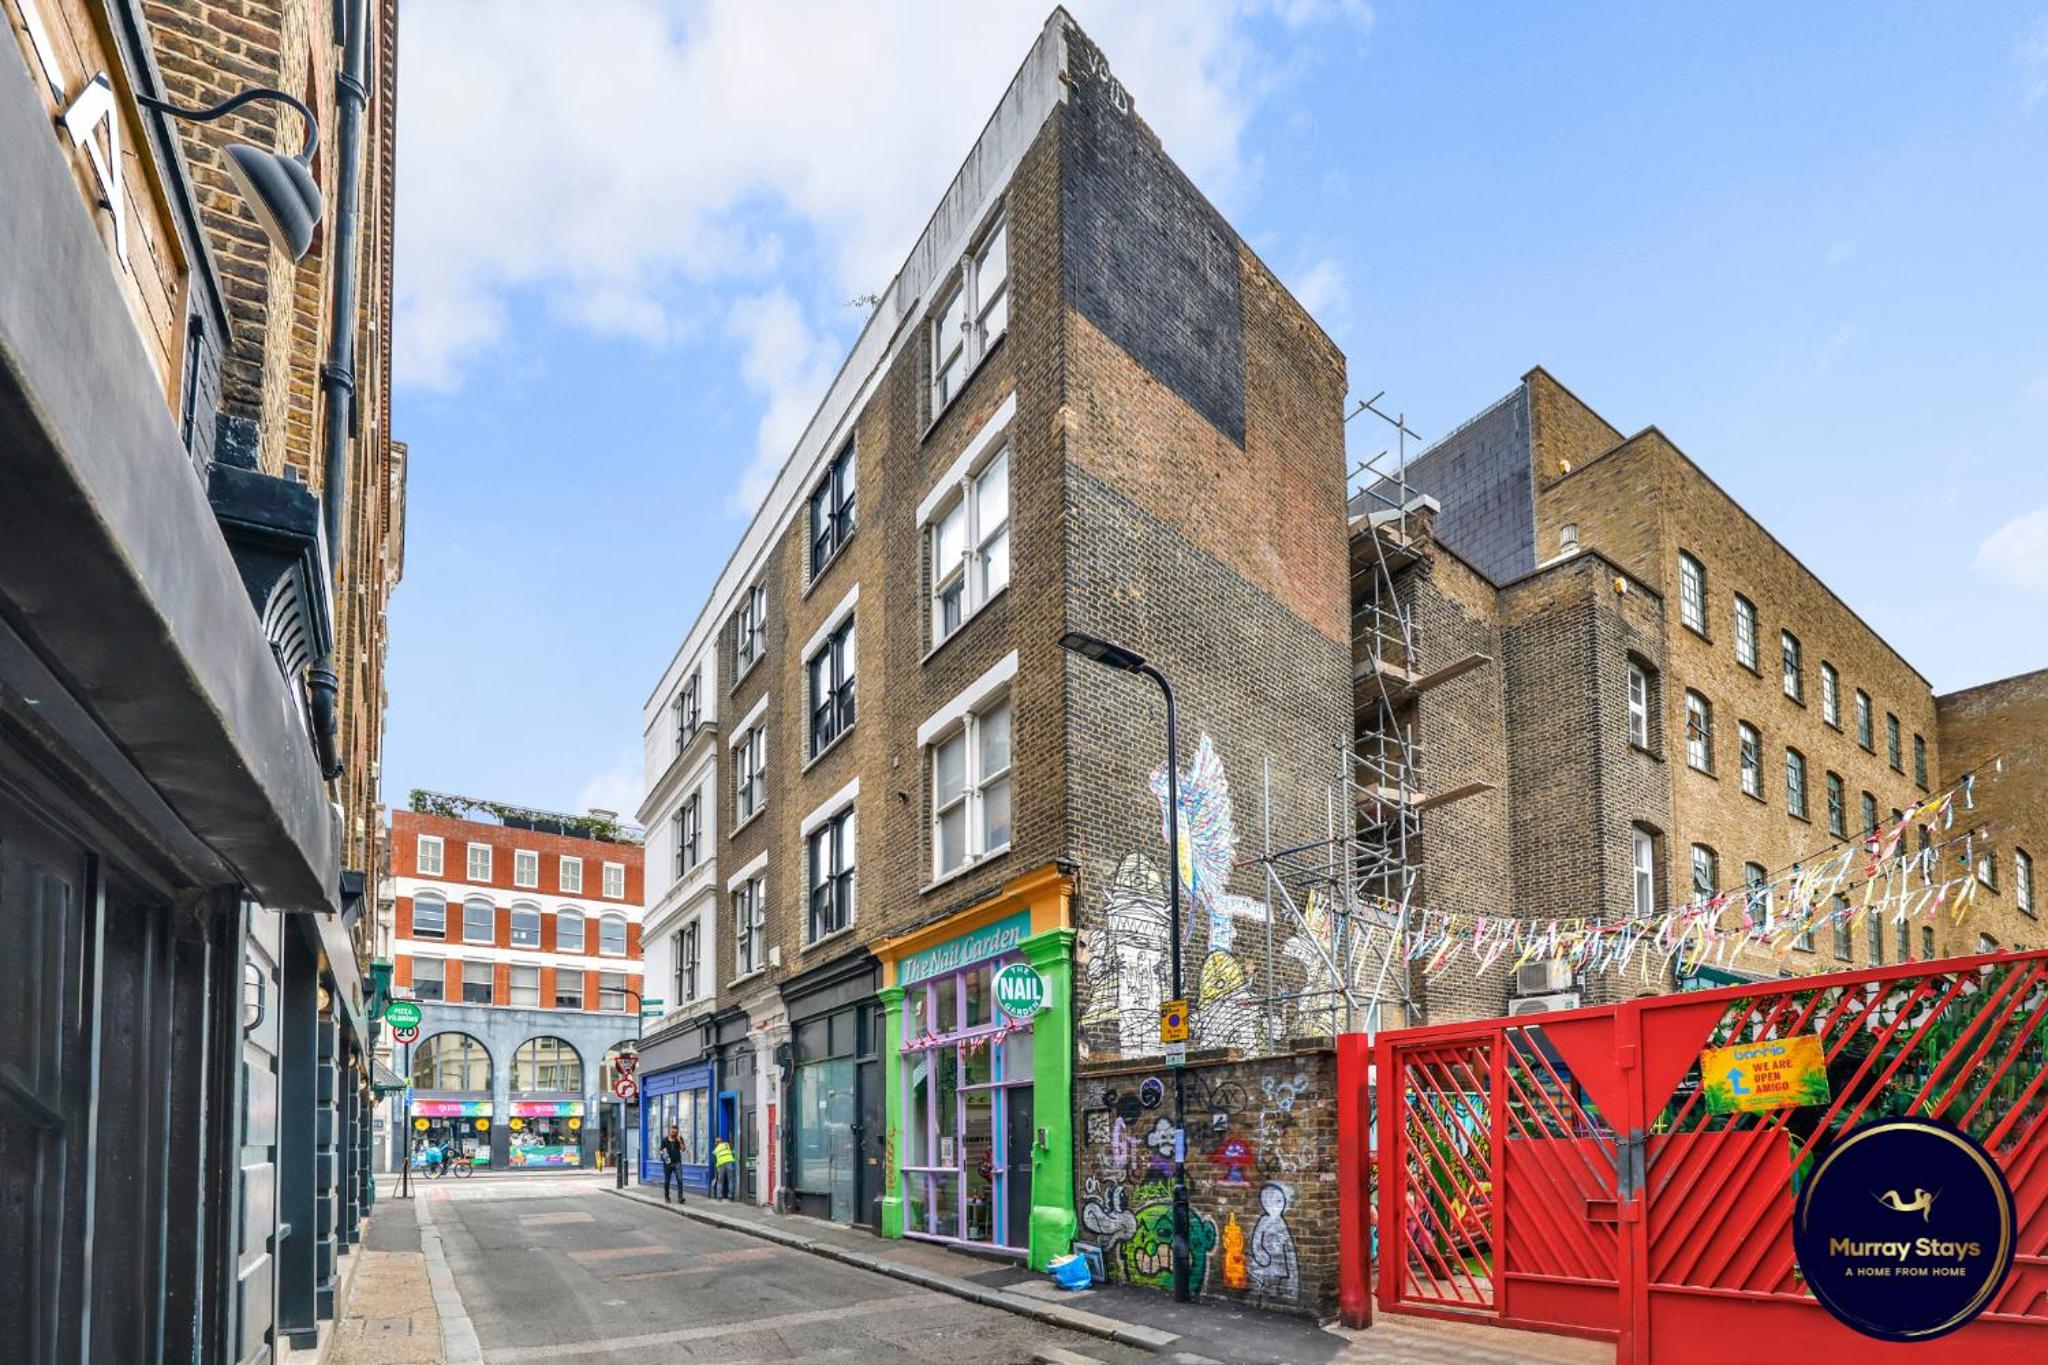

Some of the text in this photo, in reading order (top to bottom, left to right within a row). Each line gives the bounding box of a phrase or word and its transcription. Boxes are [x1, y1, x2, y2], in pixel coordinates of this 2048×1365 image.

[905, 926, 1020, 981] The Nail Garden
[1010, 966, 1030, 975] THE
[1000, 976, 1041, 1000] NAIL
[1004, 1000, 1039, 1016] GARDEN
[397, 1027, 415, 1037] 20
[1752, 1059, 1793, 1072] WE ARE
[1754, 1071, 1781, 1083] OPEN
[1756, 1081, 1789, 1093] AMIGO
